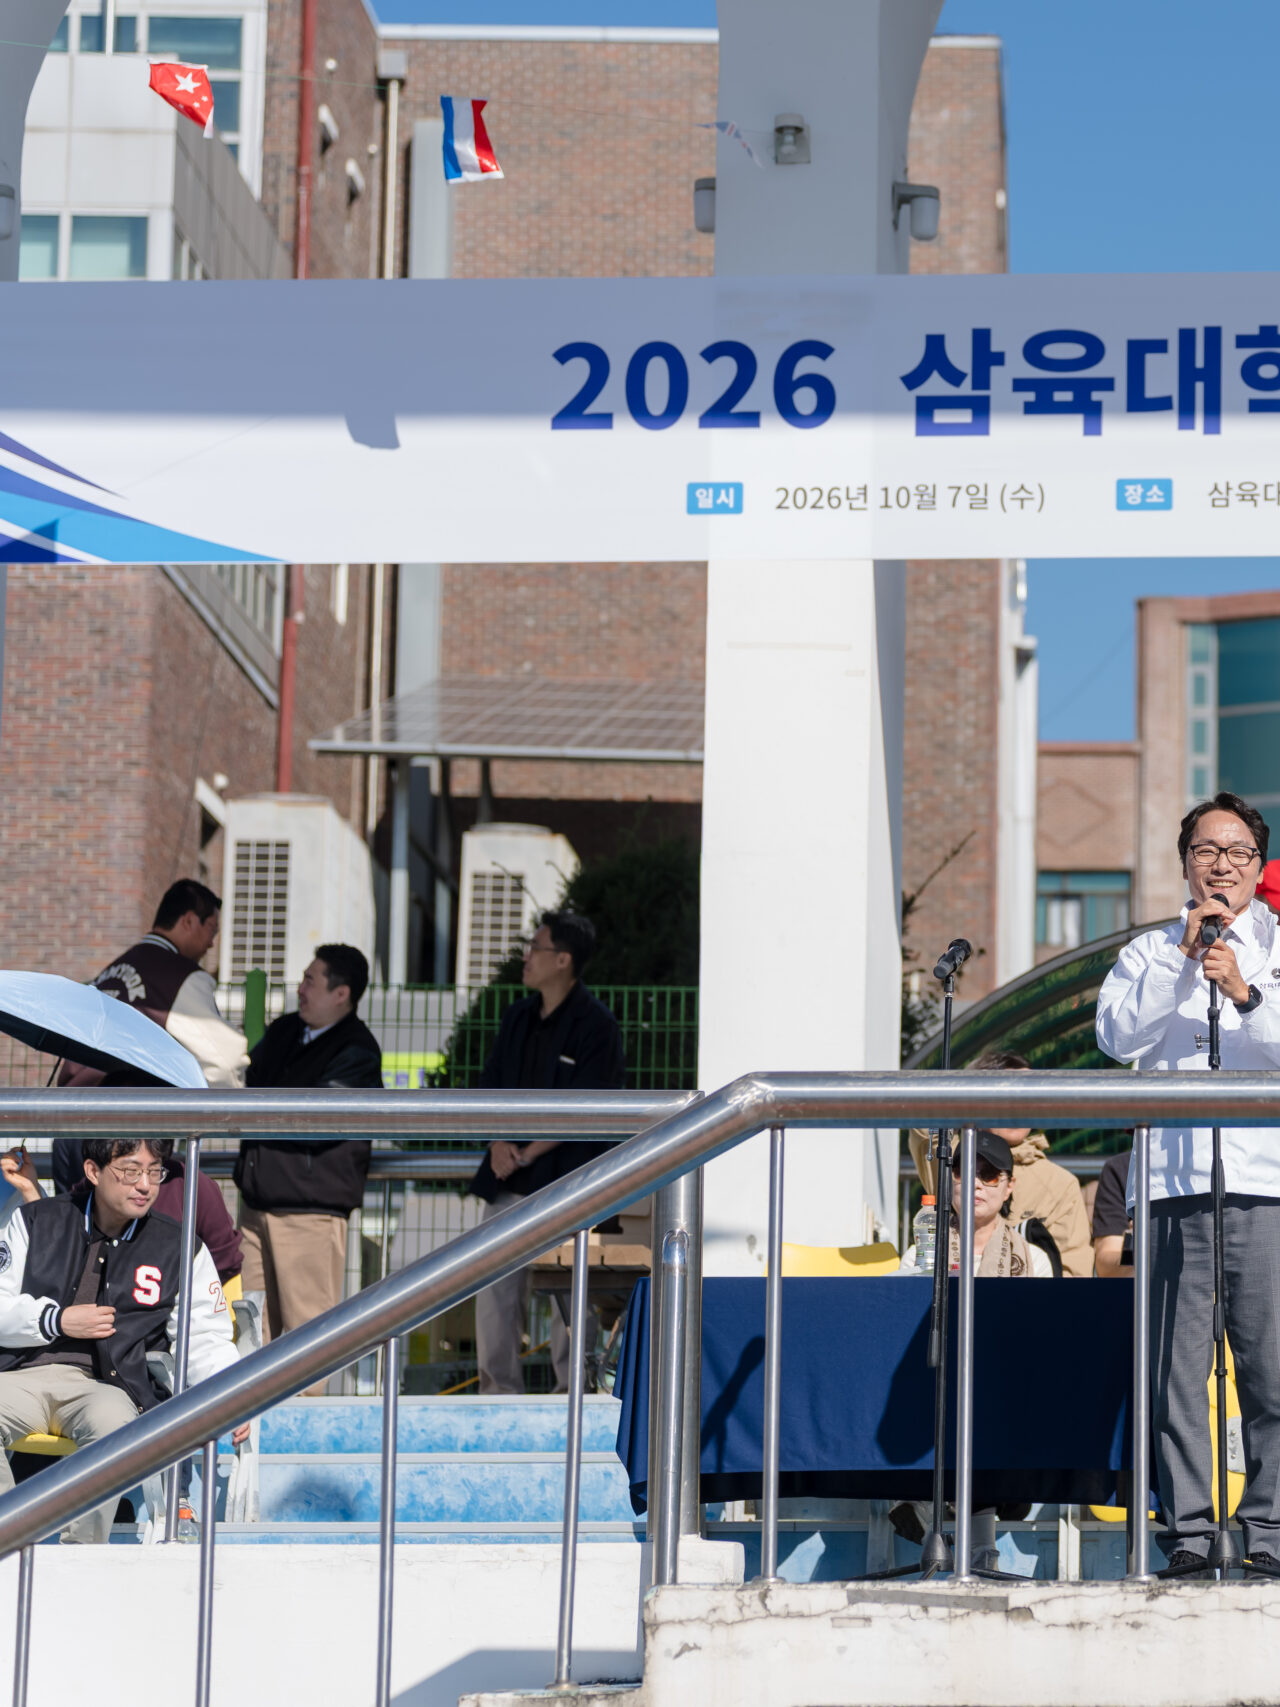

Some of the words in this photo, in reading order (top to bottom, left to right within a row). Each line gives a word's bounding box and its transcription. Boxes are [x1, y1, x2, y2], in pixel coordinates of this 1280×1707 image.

[551, 338, 837, 431] 2026
[695, 486, 735, 510] 일시
[775, 484, 868, 511] 2026년
[879, 483, 937, 511] 10월
[947, 483, 988, 510] 7일
[1000, 483, 1045, 513] (수)
[1124, 484, 1165, 505] 장소
[132, 1264, 162, 1306] S
